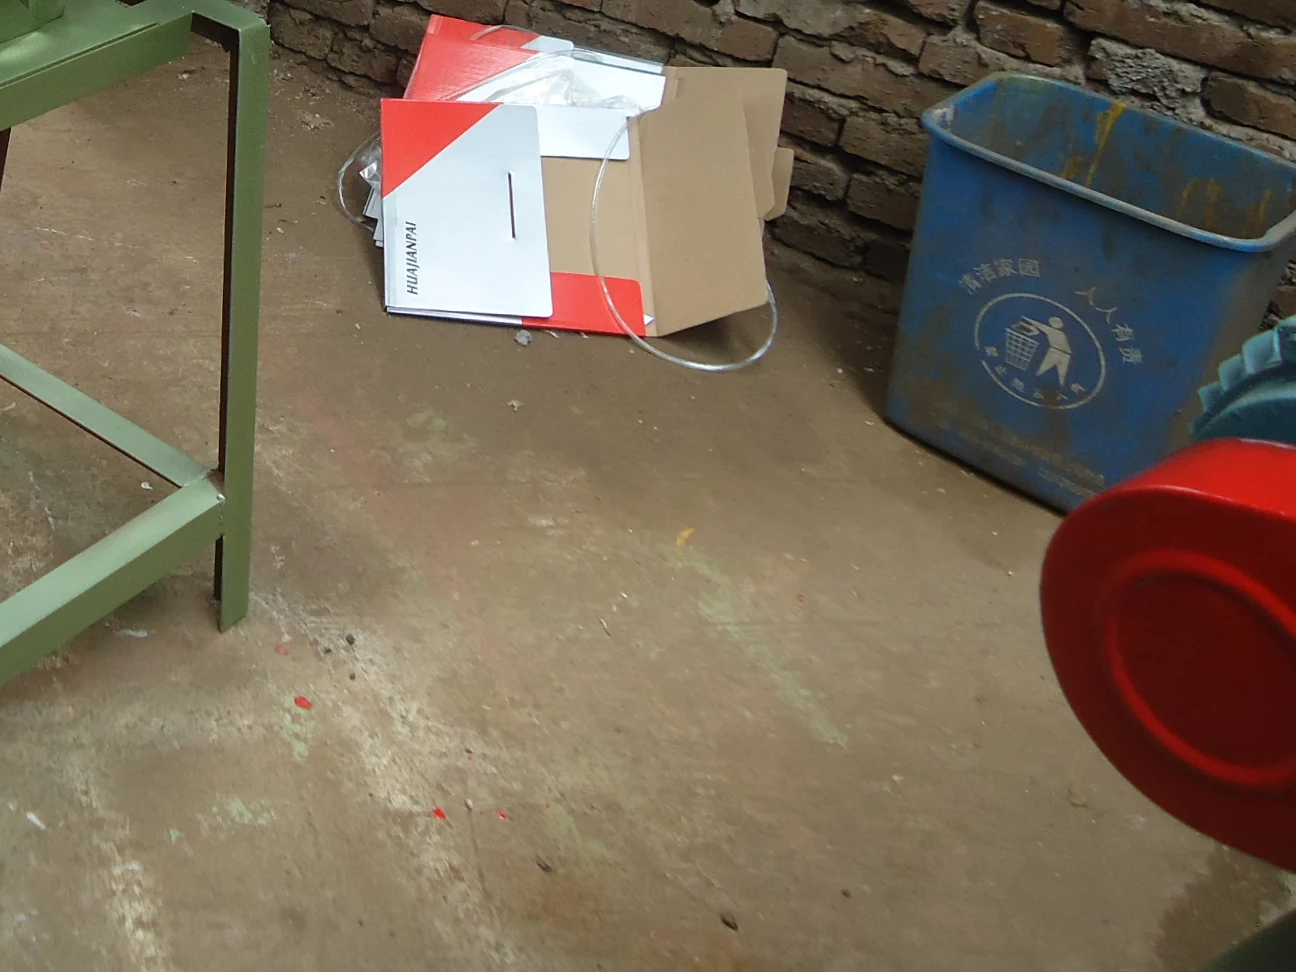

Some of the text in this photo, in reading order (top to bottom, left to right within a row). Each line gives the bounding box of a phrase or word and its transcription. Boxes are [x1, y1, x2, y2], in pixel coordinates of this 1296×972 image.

[405, 221, 420, 295] HUAJIANPAI
[958, 258, 1144, 364] 清洁家园 人人有责
